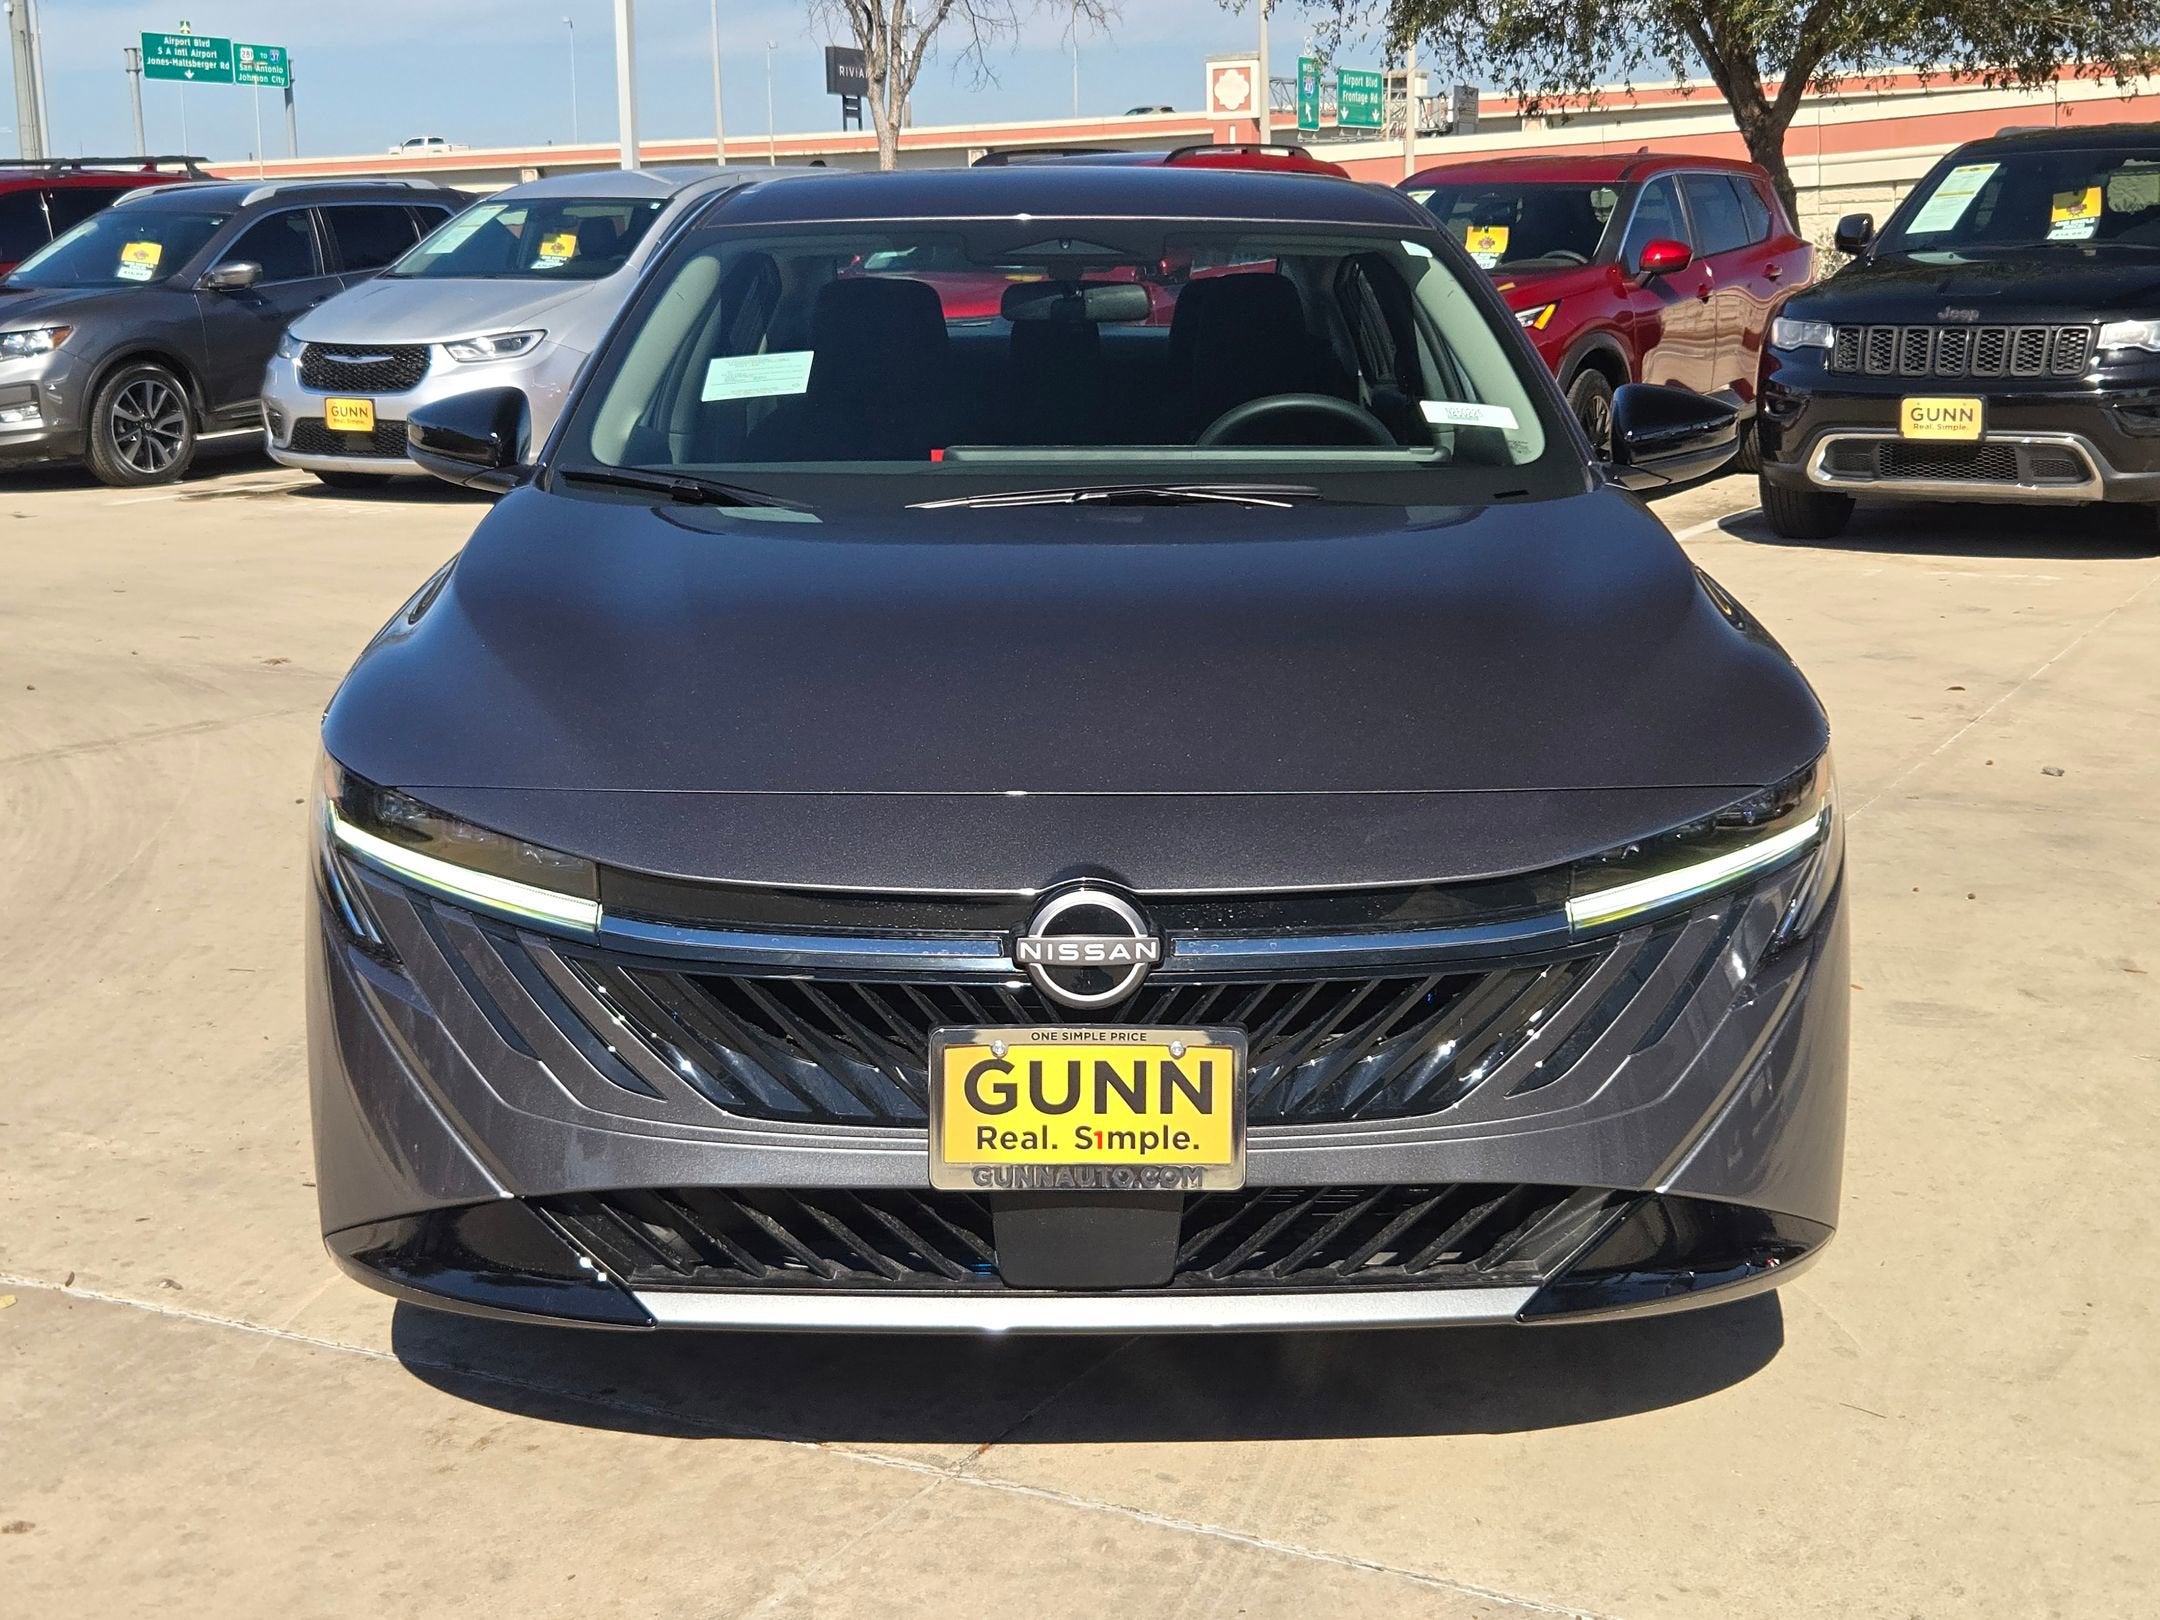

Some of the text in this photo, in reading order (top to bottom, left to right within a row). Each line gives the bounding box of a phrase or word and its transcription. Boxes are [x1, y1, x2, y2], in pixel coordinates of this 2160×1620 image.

[164, 36, 211, 48] Airport Blvd
[157, 47, 163, 55] S
[165, 47, 172, 55] A
[191, 49, 217, 59] Airport
[146, 57, 230, 70] Jones-Maltsberger Rd
[255, 64, 284, 74] Antonio
[271, 75, 286, 86] City
[1343, 74, 1378, 88] Airport Blvd
[1342, 91, 1378, 105] Frontage Rd
[1937, 305, 1979, 322] Jeep
[331, 406, 369, 417] GUNN
[1910, 407, 1974, 422] GUNN
[1019, 942, 1157, 961] NISSAN
[1031, 1031, 1147, 1042] ONE SIMPLE PRICE
[964, 1059, 1213, 1115] GUNN
[976, 1126, 1058, 1150] Real.
[972, 1166, 1204, 1188] GUNNAUTO.COM
